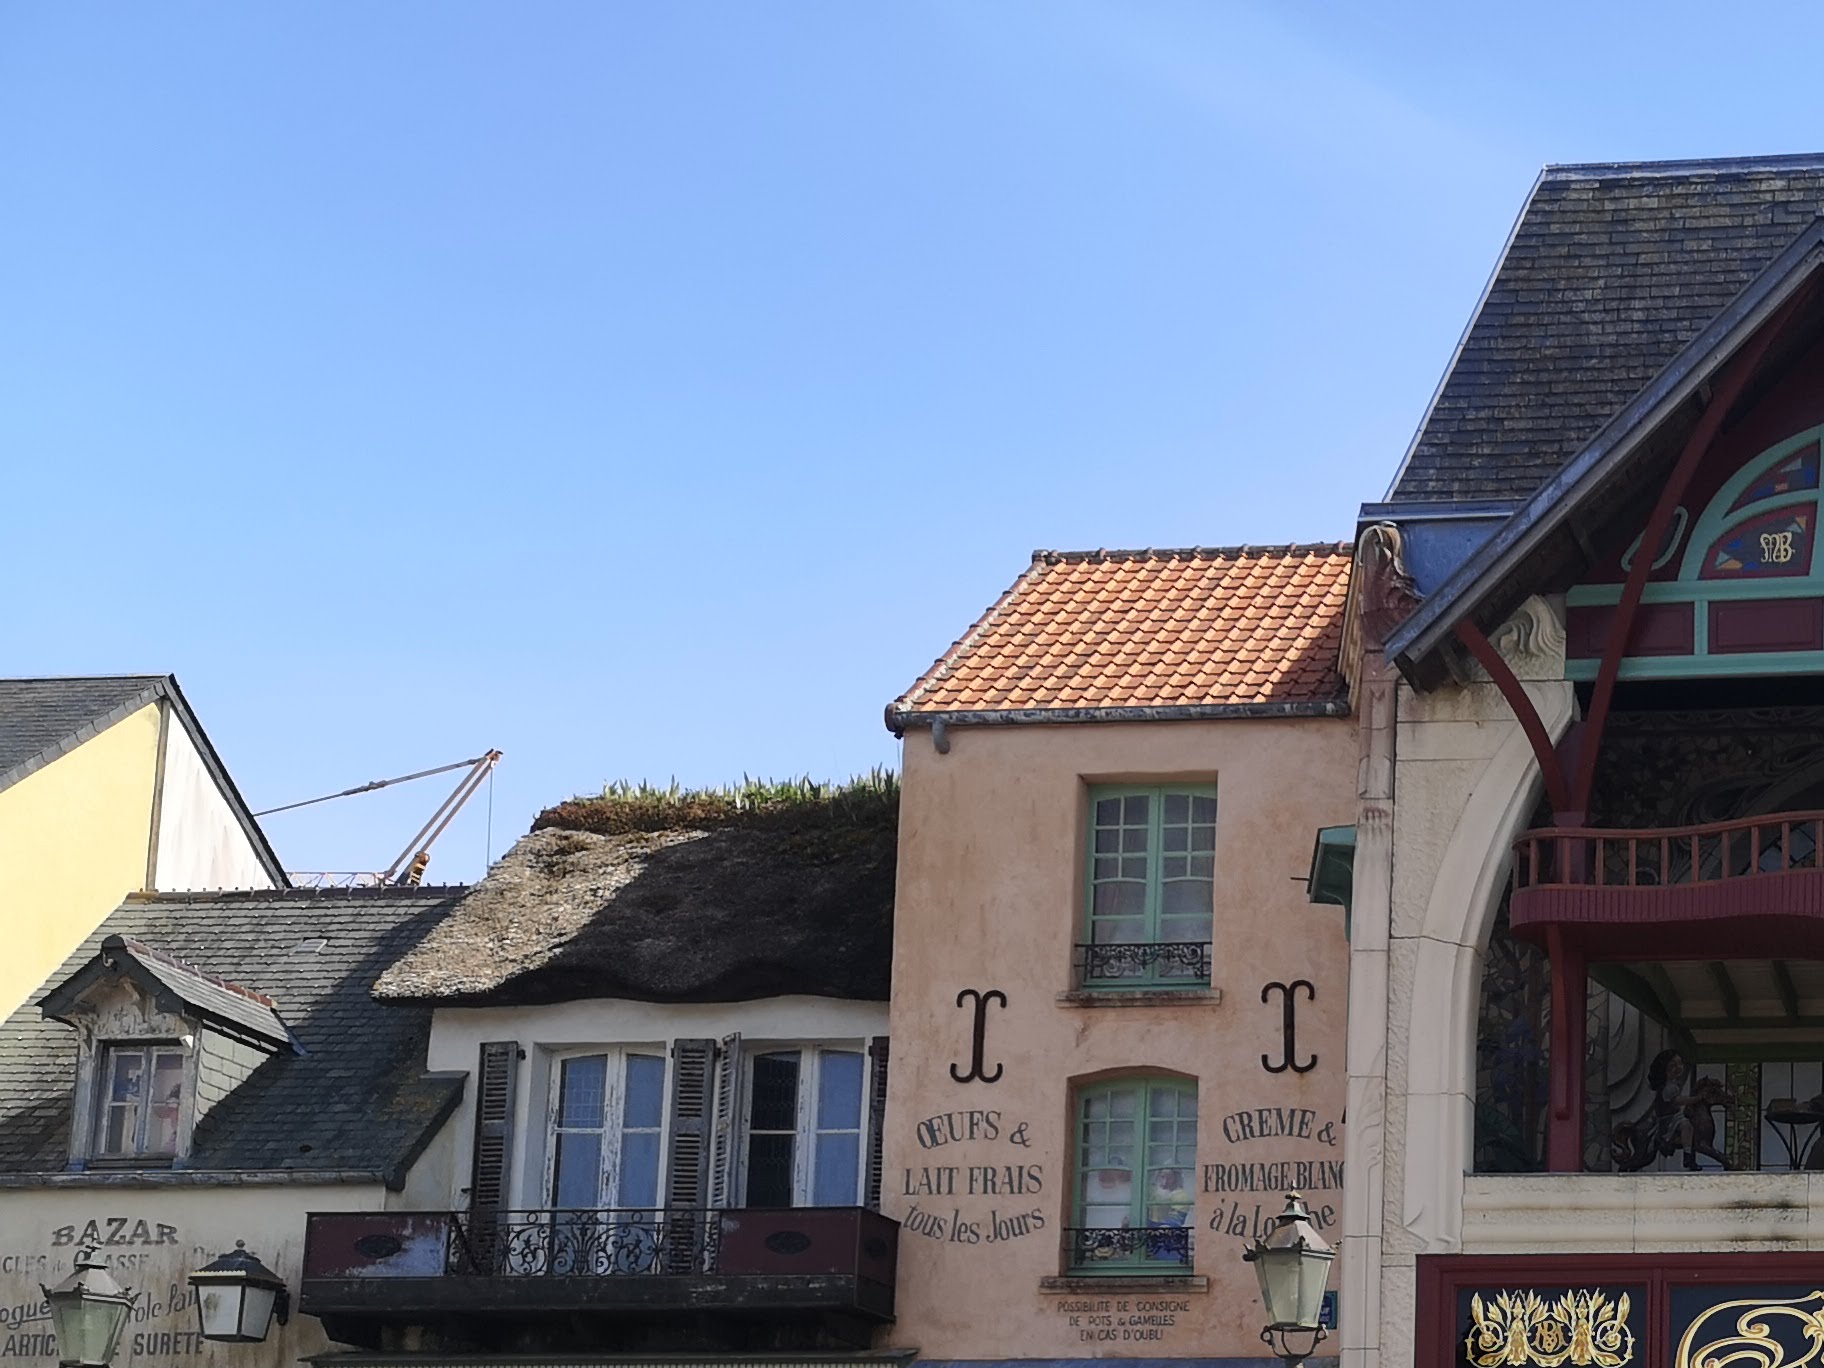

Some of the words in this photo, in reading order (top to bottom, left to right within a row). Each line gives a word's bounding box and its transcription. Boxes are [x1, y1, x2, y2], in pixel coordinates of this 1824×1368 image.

[1009, 1122, 1031, 1148] &
[1223, 1107, 1316, 1144] CREME
[1317, 1121, 1337, 1147] &
[902, 1167, 959, 1196] LAIT
[967, 1164, 1043, 1195] FRAIS
[1203, 1162, 1290, 1193] FROMAGE
[51, 1217, 179, 1247] BAZAR
[903, 1204, 947, 1240] tous
[948, 1208, 980, 1244] les
[986, 1208, 1045, 1243] Jours
[1226, 1202, 1247, 1237] la
[1057, 1301, 1110, 1312] POSSIBILITE
[1118, 1301, 1129, 1311] DE
[1137, 1301, 1190, 1311] CONSIGNE
[1069, 1316, 1080, 1326] DE
[1089, 1315, 1112, 1326] POTS
[1117, 1317, 1125, 1326] &
[1129, 1315, 1175, 1326] GAMELLES
[134, 1332, 204, 1356] SURETE
[1080, 1330, 1093, 1341] EN
[1098, 1329, 1117, 1340] CAS
